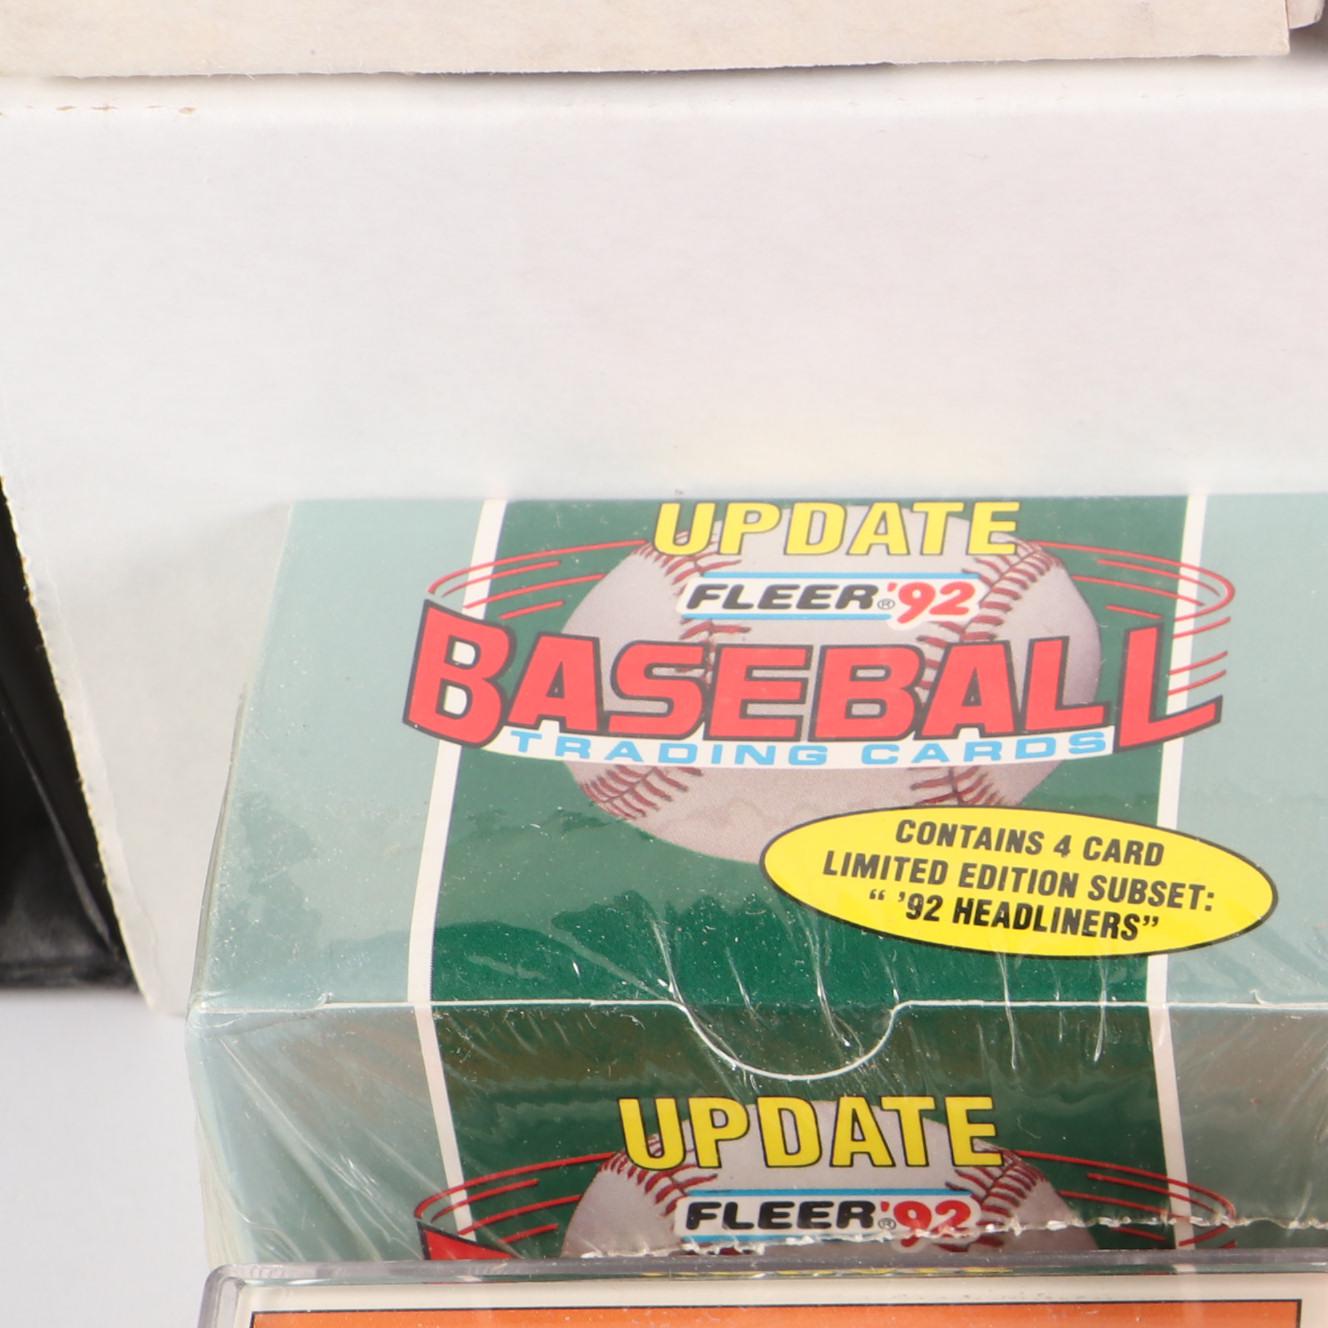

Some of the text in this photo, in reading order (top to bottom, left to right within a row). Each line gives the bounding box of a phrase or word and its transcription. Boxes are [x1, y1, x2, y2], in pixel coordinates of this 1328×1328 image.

[652, 501, 1022, 557] UPDATE
[402, 598, 1223, 754] BASEBALL
[511, 731, 1107, 767] TRADING CARDS
[896, 820, 1165, 867] CONTAINS 4 CARD
[823, 851, 1215, 912] LIMITED EDITION SUBSET:
[952, 898, 1160, 941] HEADLINERS”
[618, 1094, 1003, 1171] UPDATE
